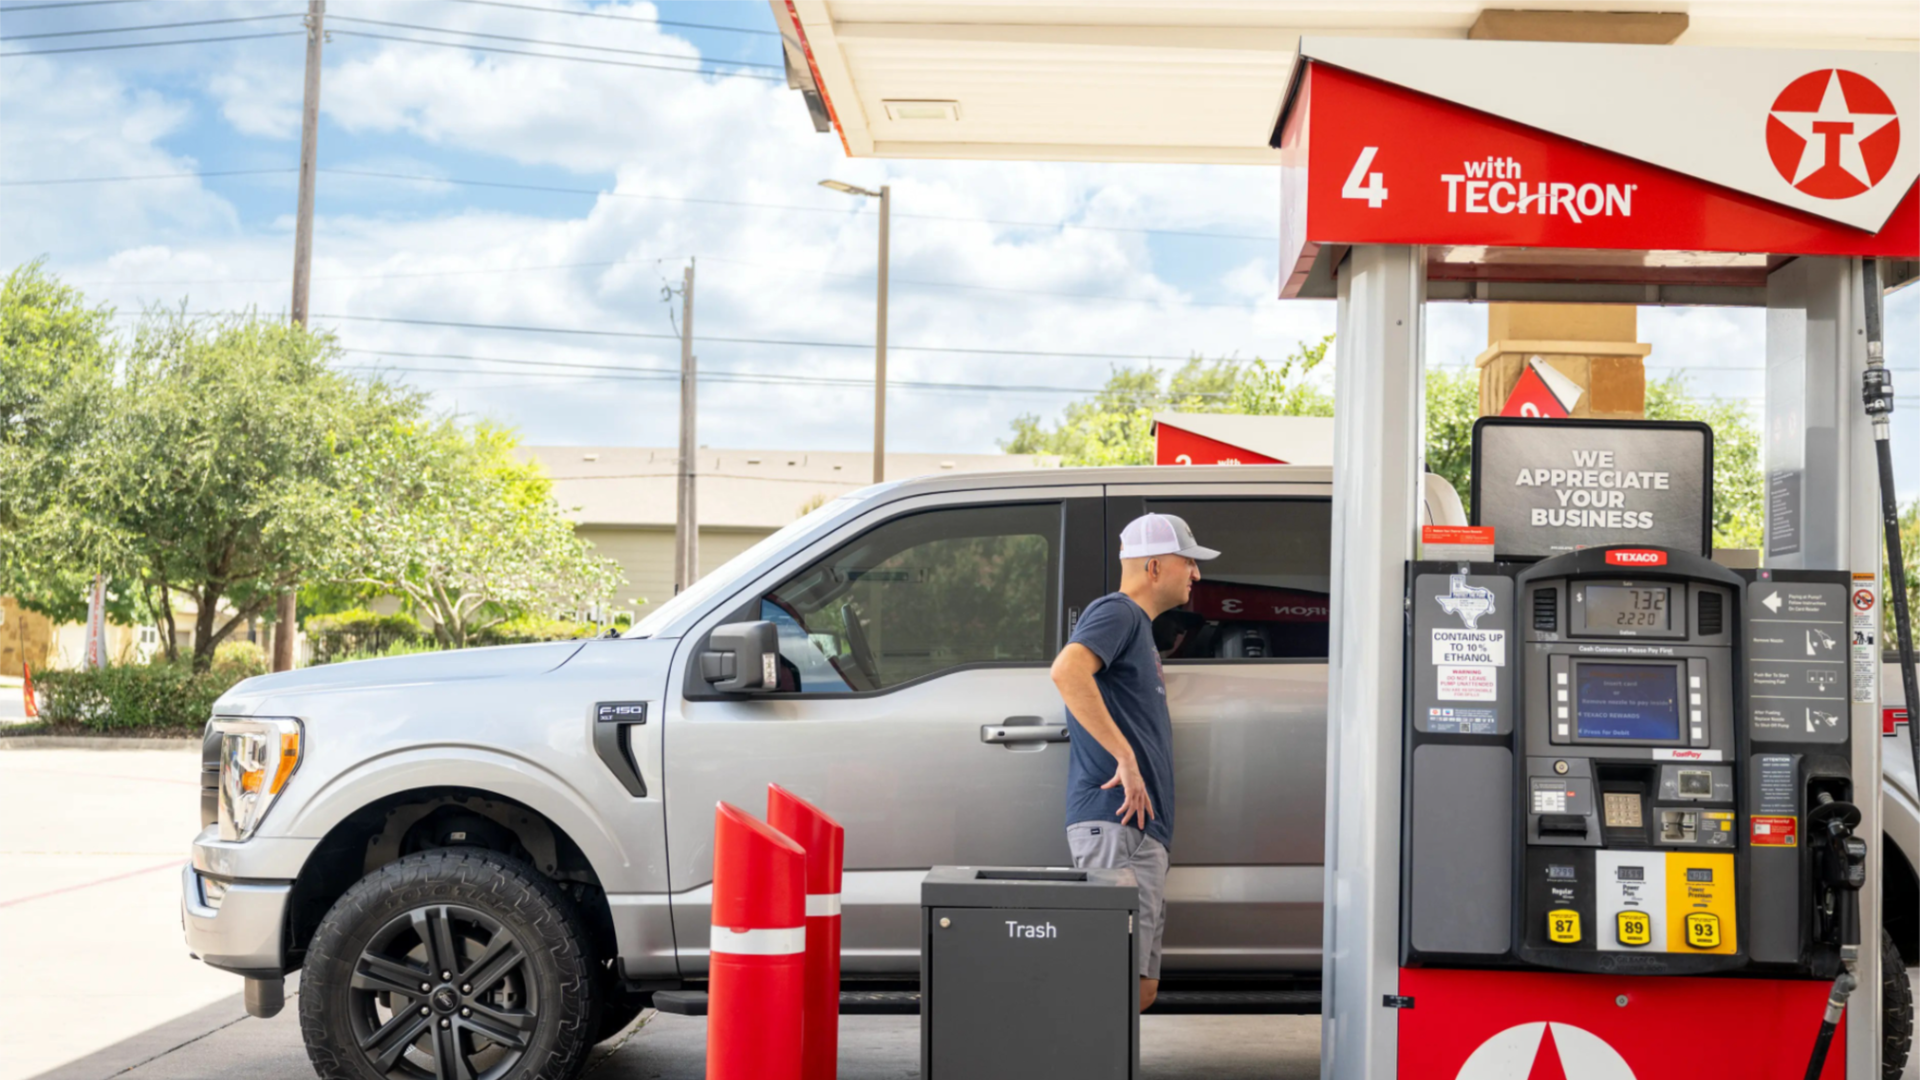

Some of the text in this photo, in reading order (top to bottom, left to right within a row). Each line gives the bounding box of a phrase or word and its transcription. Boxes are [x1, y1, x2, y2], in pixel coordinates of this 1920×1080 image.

[1464, 156, 1521, 179] with
[1341, 146, 1388, 208] 4
[1441, 174, 1632, 223] TECHRON
[1572, 450, 1614, 468] WE
[1515, 468, 1669, 490] APPRECIATE
[1556, 489, 1625, 508] YOUR
[1531, 508, 1654, 529] BUSINESS
[1615, 553, 1658, 562] TEXACO
[1576, 592, 1582, 602] $
[1630, 590, 1666, 610] 7.32
[1617, 612, 1656, 626] 2.220
[1434, 632, 1503, 642] CONTAINS UP
[1450, 643, 1464, 652] TO
[1444, 653, 1493, 662] ETHANOL
[1672, 750, 1701, 759] FastPay
[384, 884, 452, 909] TOYO
[1552, 887, 1574, 896] Regular
[1005, 921, 1058, 939] Trash
[1555, 920, 1574, 933] 87
[1625, 921, 1644, 934] 89
[1694, 924, 1713, 937] 93
